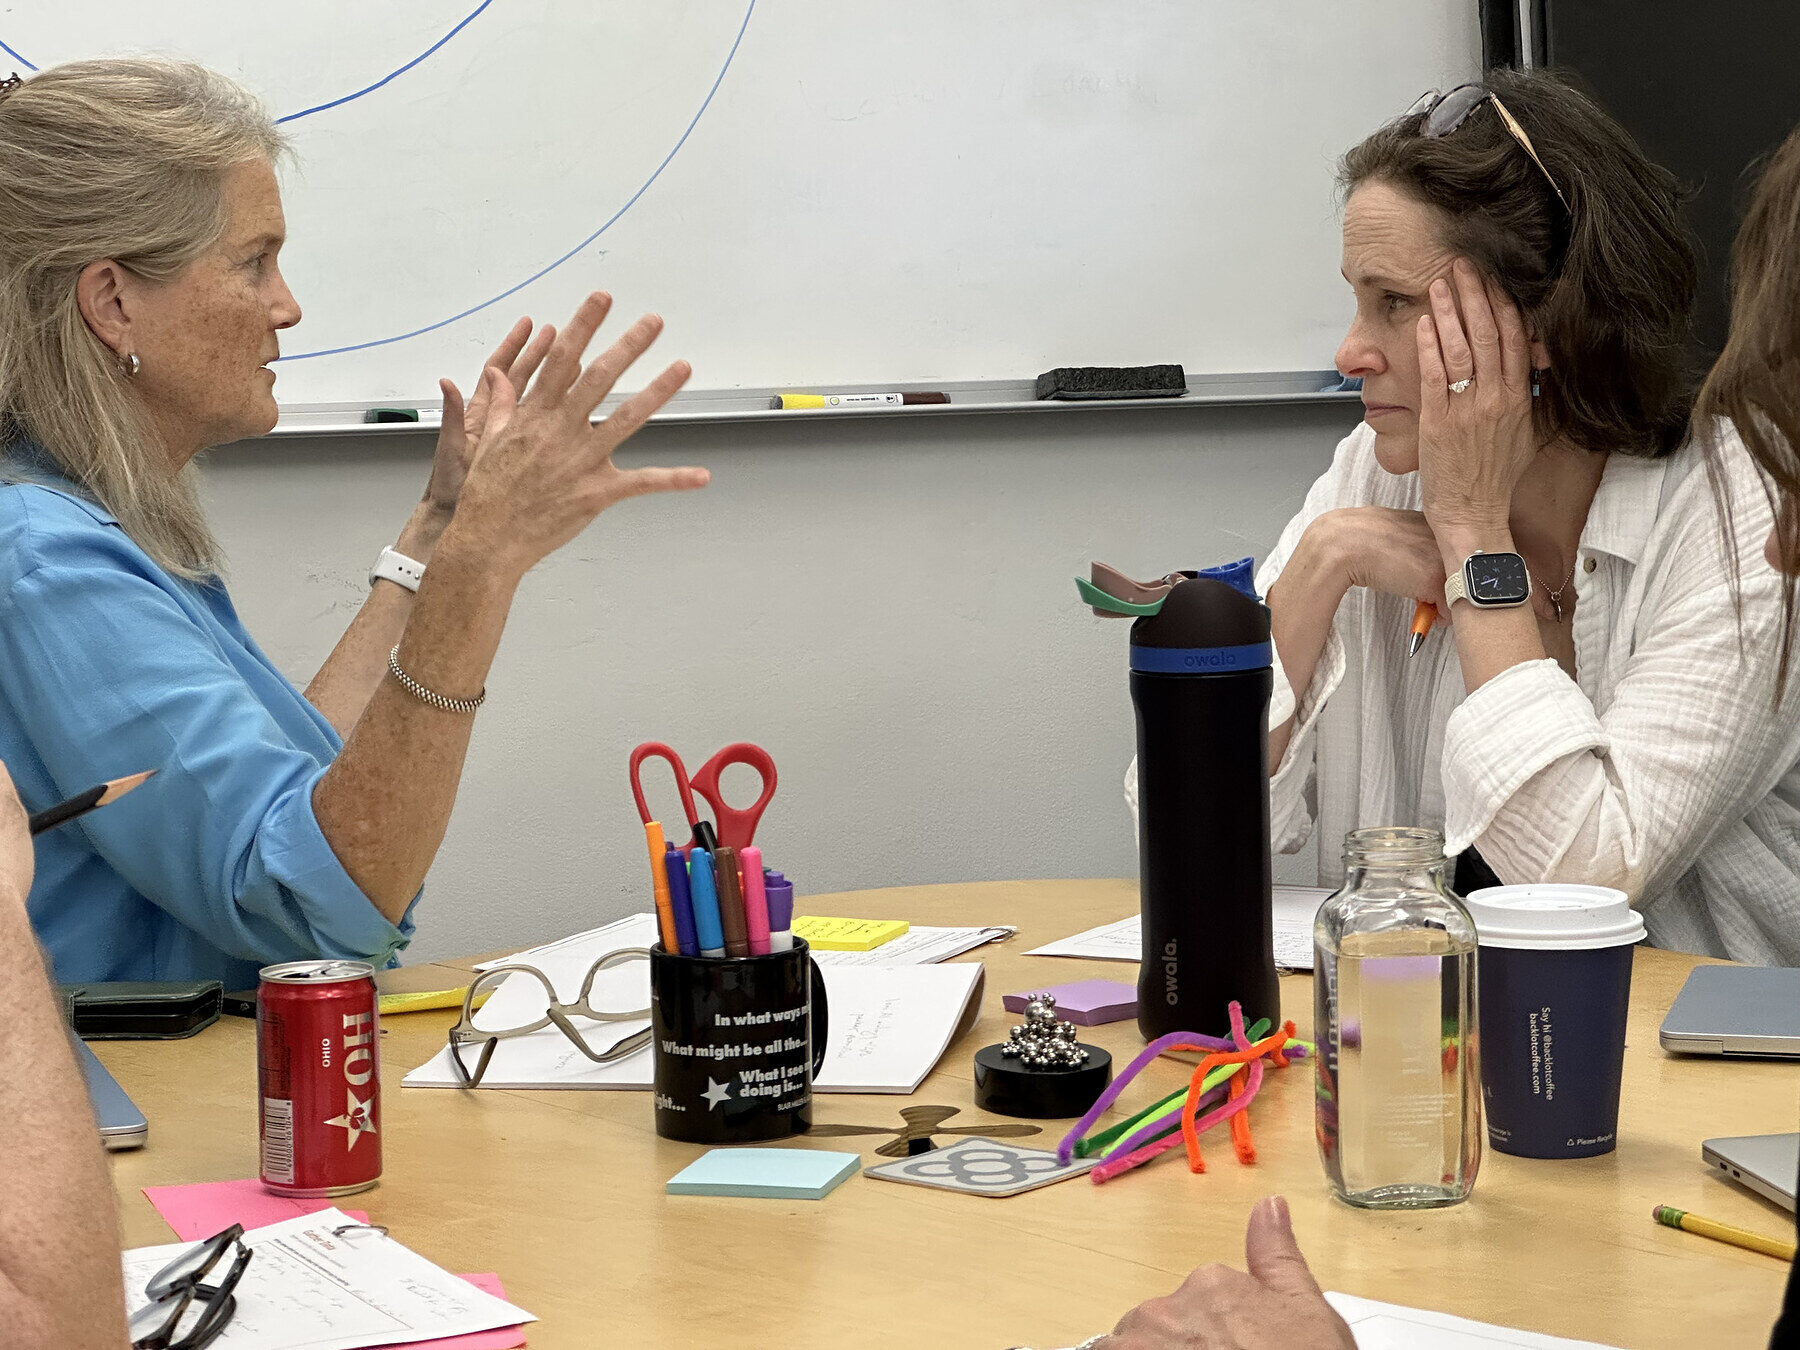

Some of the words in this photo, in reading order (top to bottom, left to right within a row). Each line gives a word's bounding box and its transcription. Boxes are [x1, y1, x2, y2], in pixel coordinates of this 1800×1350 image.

[1184, 651, 1236, 667] owala
[715, 1013, 731, 1026] In
[733, 1011, 771, 1026] what
[773, 1008, 801, 1022] ways
[1540, 1006, 1551, 1023] Say
[1543, 1024, 1552, 1034] hi
[321, 1038, 330, 1068] OHIO
[662, 1040, 693, 1056] What
[695, 1043, 741, 1061] might
[743, 1044, 762, 1056] be
[764, 1039, 783, 1054] all
[1529, 1013, 1541, 1094] backlotcoffee.com
[739, 1067, 779, 1084] What
[780, 1066, 786, 1080] I
[787, 1064, 804, 1077] see
[1543, 1034, 1556, 1101] @backlotcoffee
[739, 1082, 781, 1098] doing
[783, 1079, 803, 1092] is...
